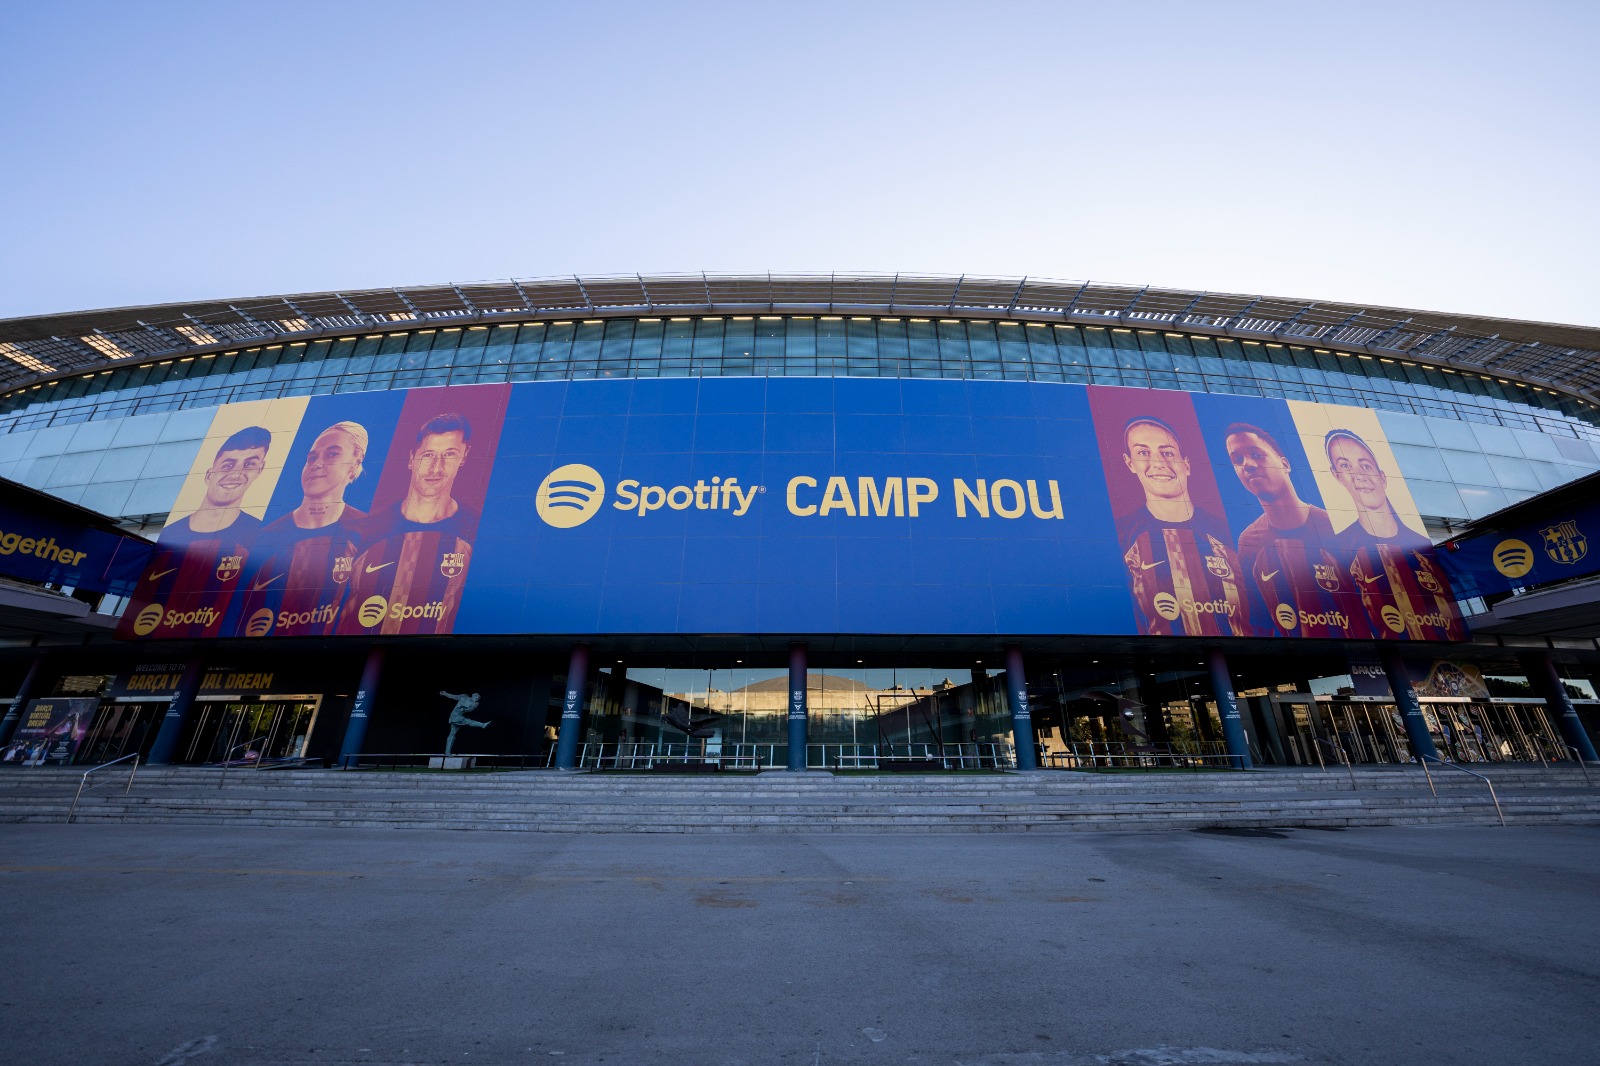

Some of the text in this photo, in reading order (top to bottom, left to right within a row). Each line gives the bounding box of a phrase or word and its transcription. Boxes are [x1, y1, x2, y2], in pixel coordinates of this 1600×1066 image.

[613, 476, 1064, 519] Spotify CAMP NOU
[0, 529, 88, 567] gether
[163, 606, 221, 629] Spotify
[276, 603, 340, 629] Spotify
[389, 601, 447, 622] Spotify
[1182, 598, 1236, 618] Spotify
[1298, 609, 1350, 630] Spotify
[1404, 611, 1451, 631] Spotify
[135, 663, 168, 672] WELCOME
[177, 663, 187, 671] TH
[126, 674, 170, 693] BARÇA
[224, 672, 275, 689] DREAM
